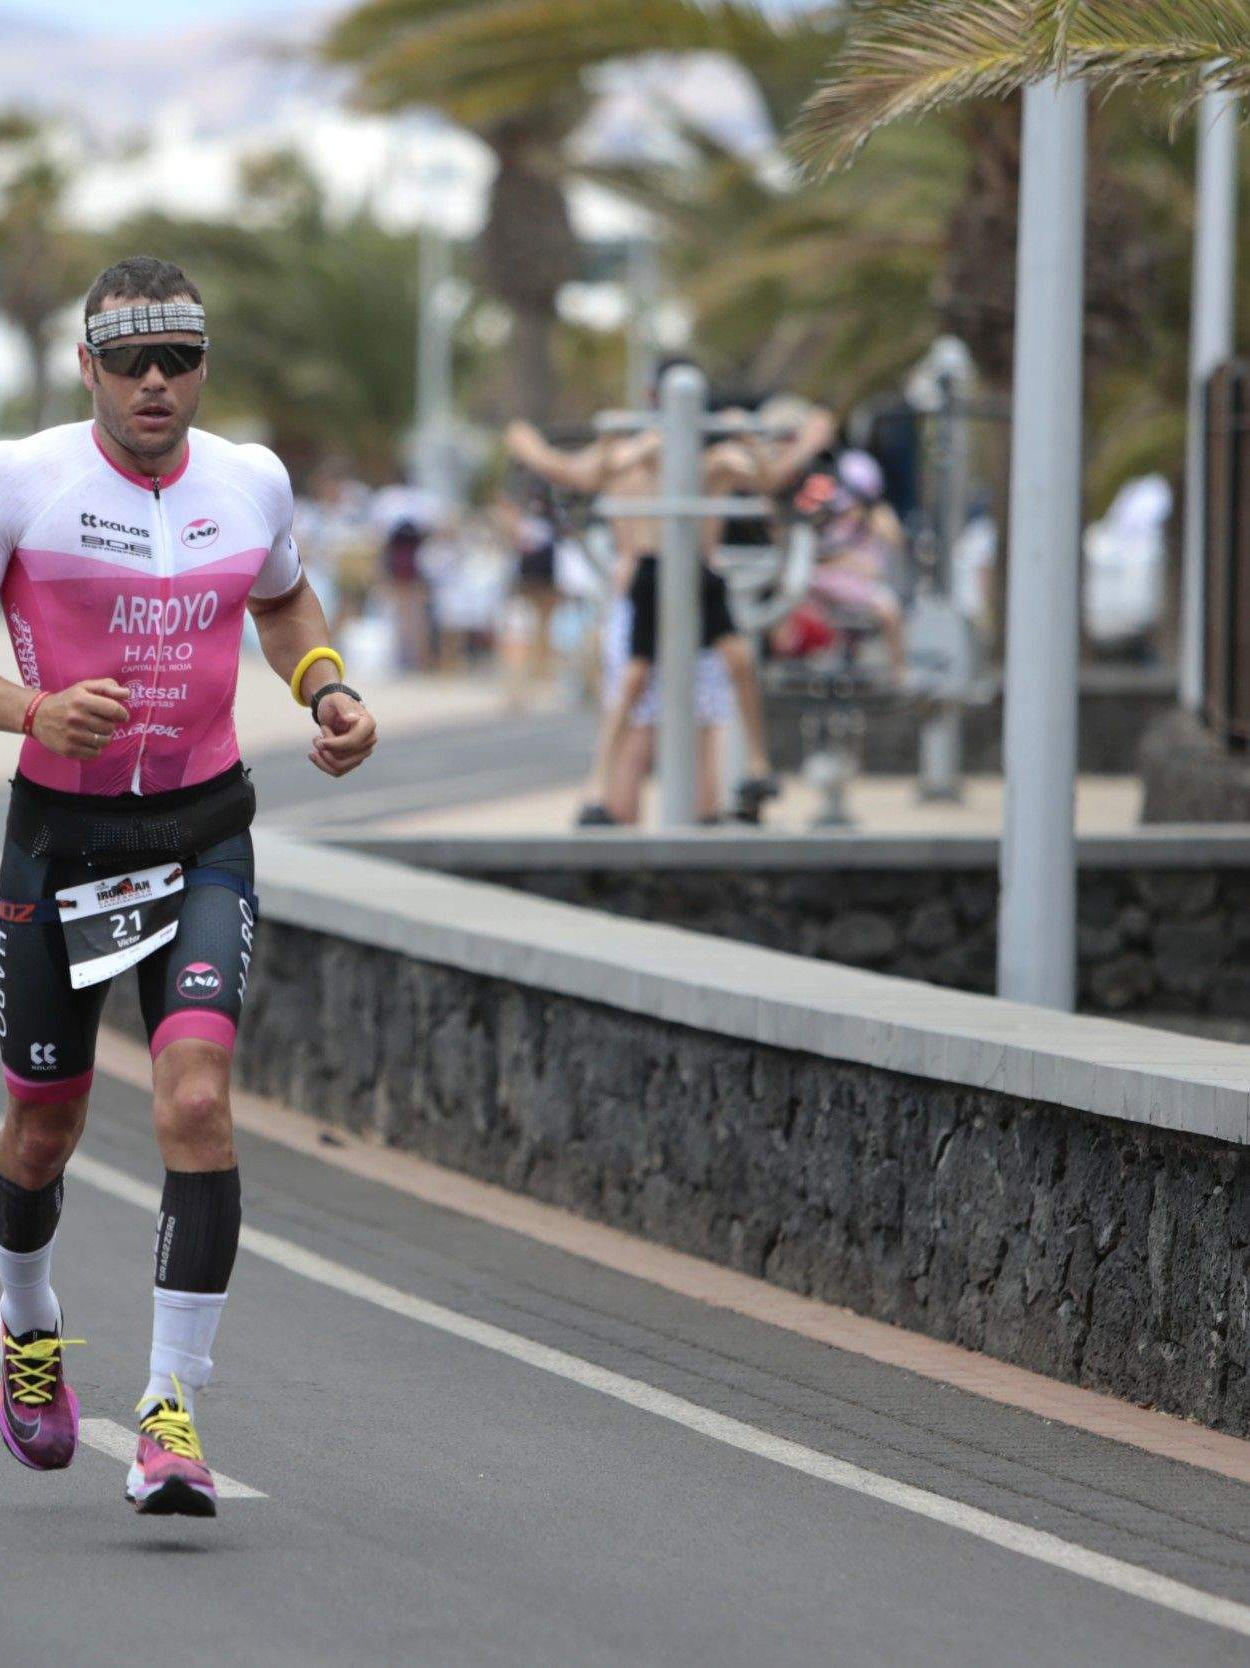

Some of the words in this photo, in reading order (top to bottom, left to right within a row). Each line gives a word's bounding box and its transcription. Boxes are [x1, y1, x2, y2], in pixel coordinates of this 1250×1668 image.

[108, 590, 218, 636] ARROYO
[124, 643, 193, 662] HARO
[110, 910, 142, 939] 21
